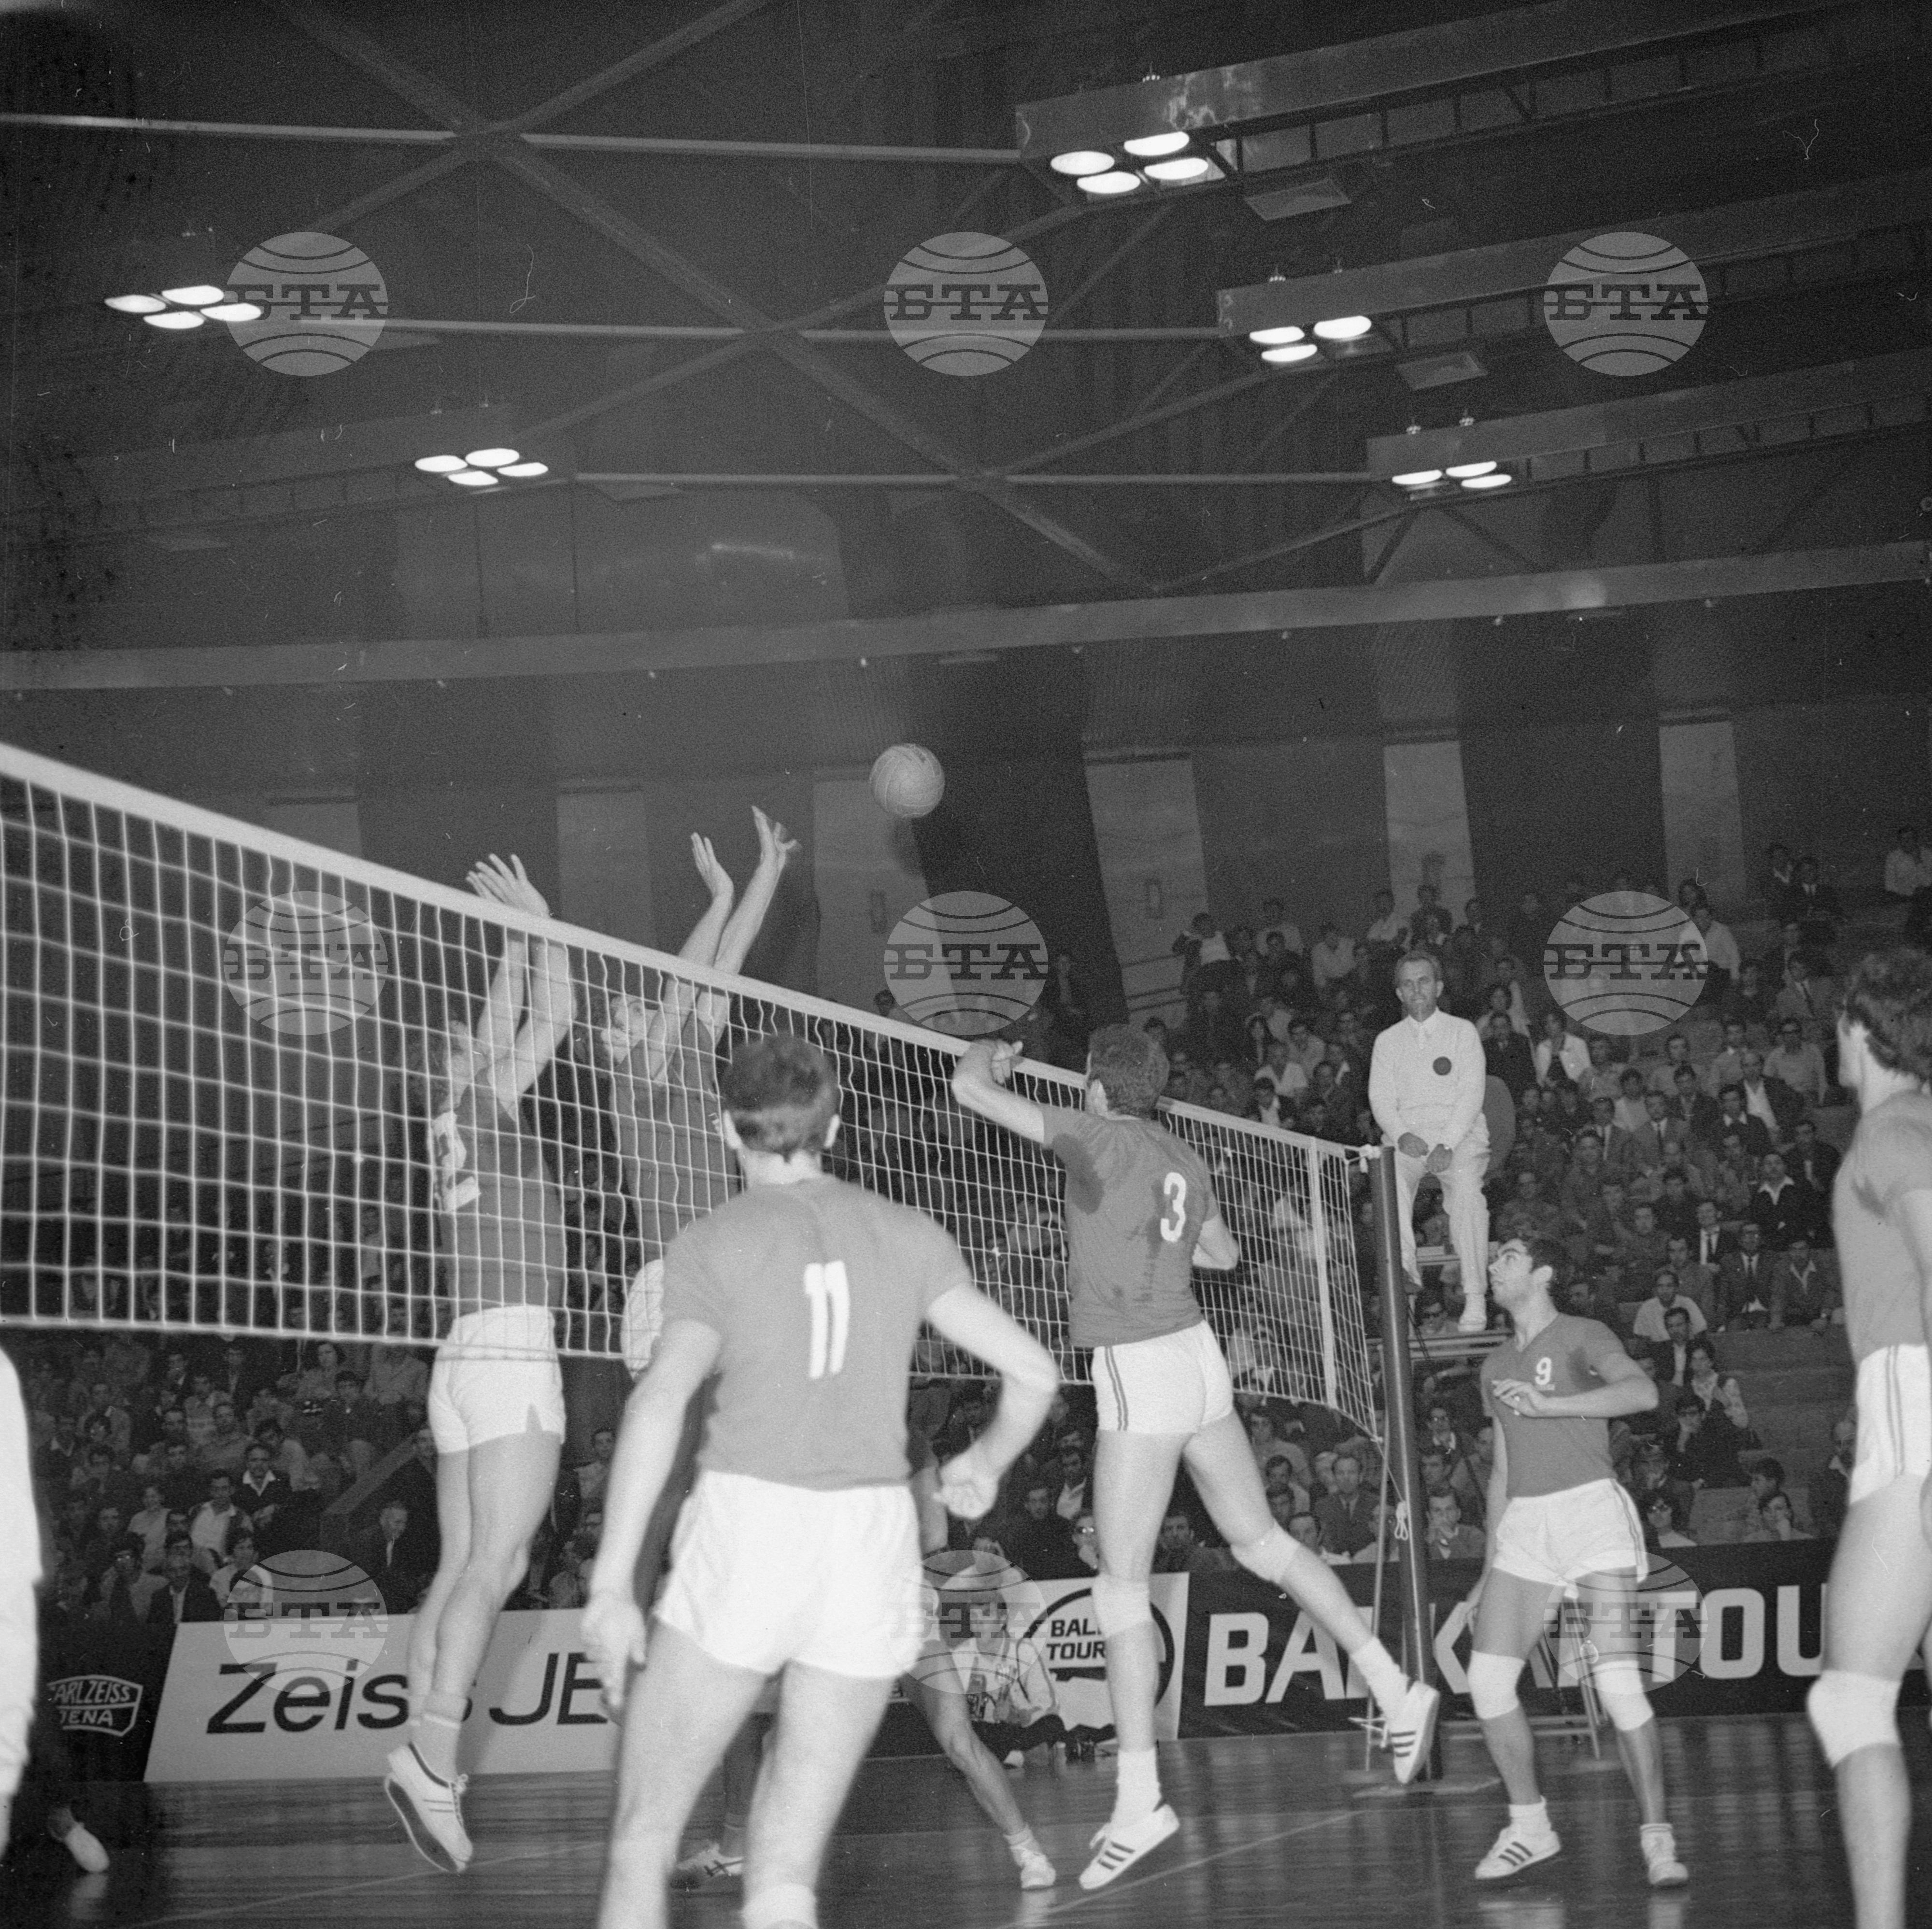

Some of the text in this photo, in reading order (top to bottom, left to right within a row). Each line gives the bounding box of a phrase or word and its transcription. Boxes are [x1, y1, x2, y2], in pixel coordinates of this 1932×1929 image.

[1161, 1172, 1186, 1243] 3
[804, 1260, 850, 1380] 11
[1535, 1357, 1552, 1386] 9
[1050, 1618, 1102, 1637] BAL
[206, 1652, 609, 1734] Zeis JE
